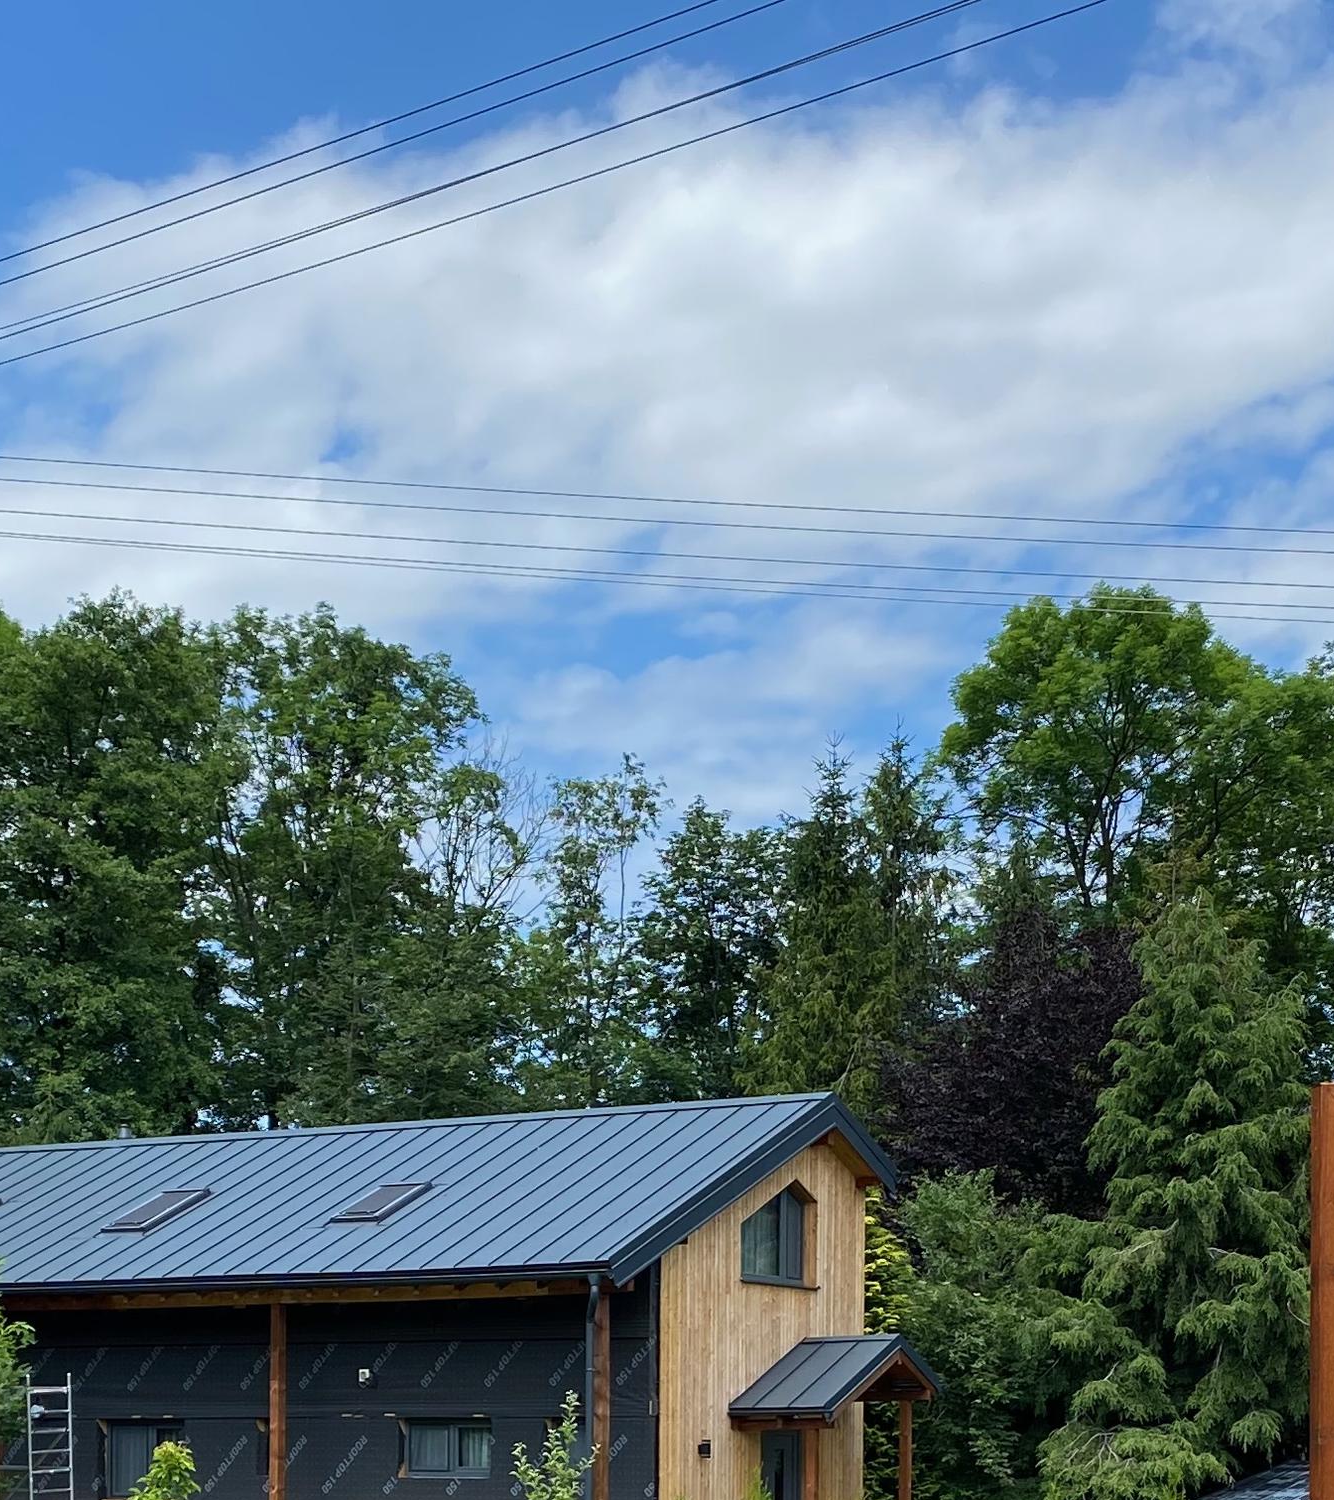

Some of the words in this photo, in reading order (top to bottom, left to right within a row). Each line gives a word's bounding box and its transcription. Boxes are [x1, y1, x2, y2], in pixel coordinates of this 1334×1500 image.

[298, 1371, 313, 1390] 150
[420, 1370, 436, 1388] 150
[483, 1368, 500, 1388] 150
[548, 1367, 565, 1387] 150
[615, 1366, 632, 1386] 150
[217, 1434, 249, 1478] ROOFTOP
[335, 1434, 369, 1478] ROOFTOP
[203, 1475, 219, 1493] 150
[321, 1476, 337, 1494] 150
[382, 1475, 399, 1495] 150
